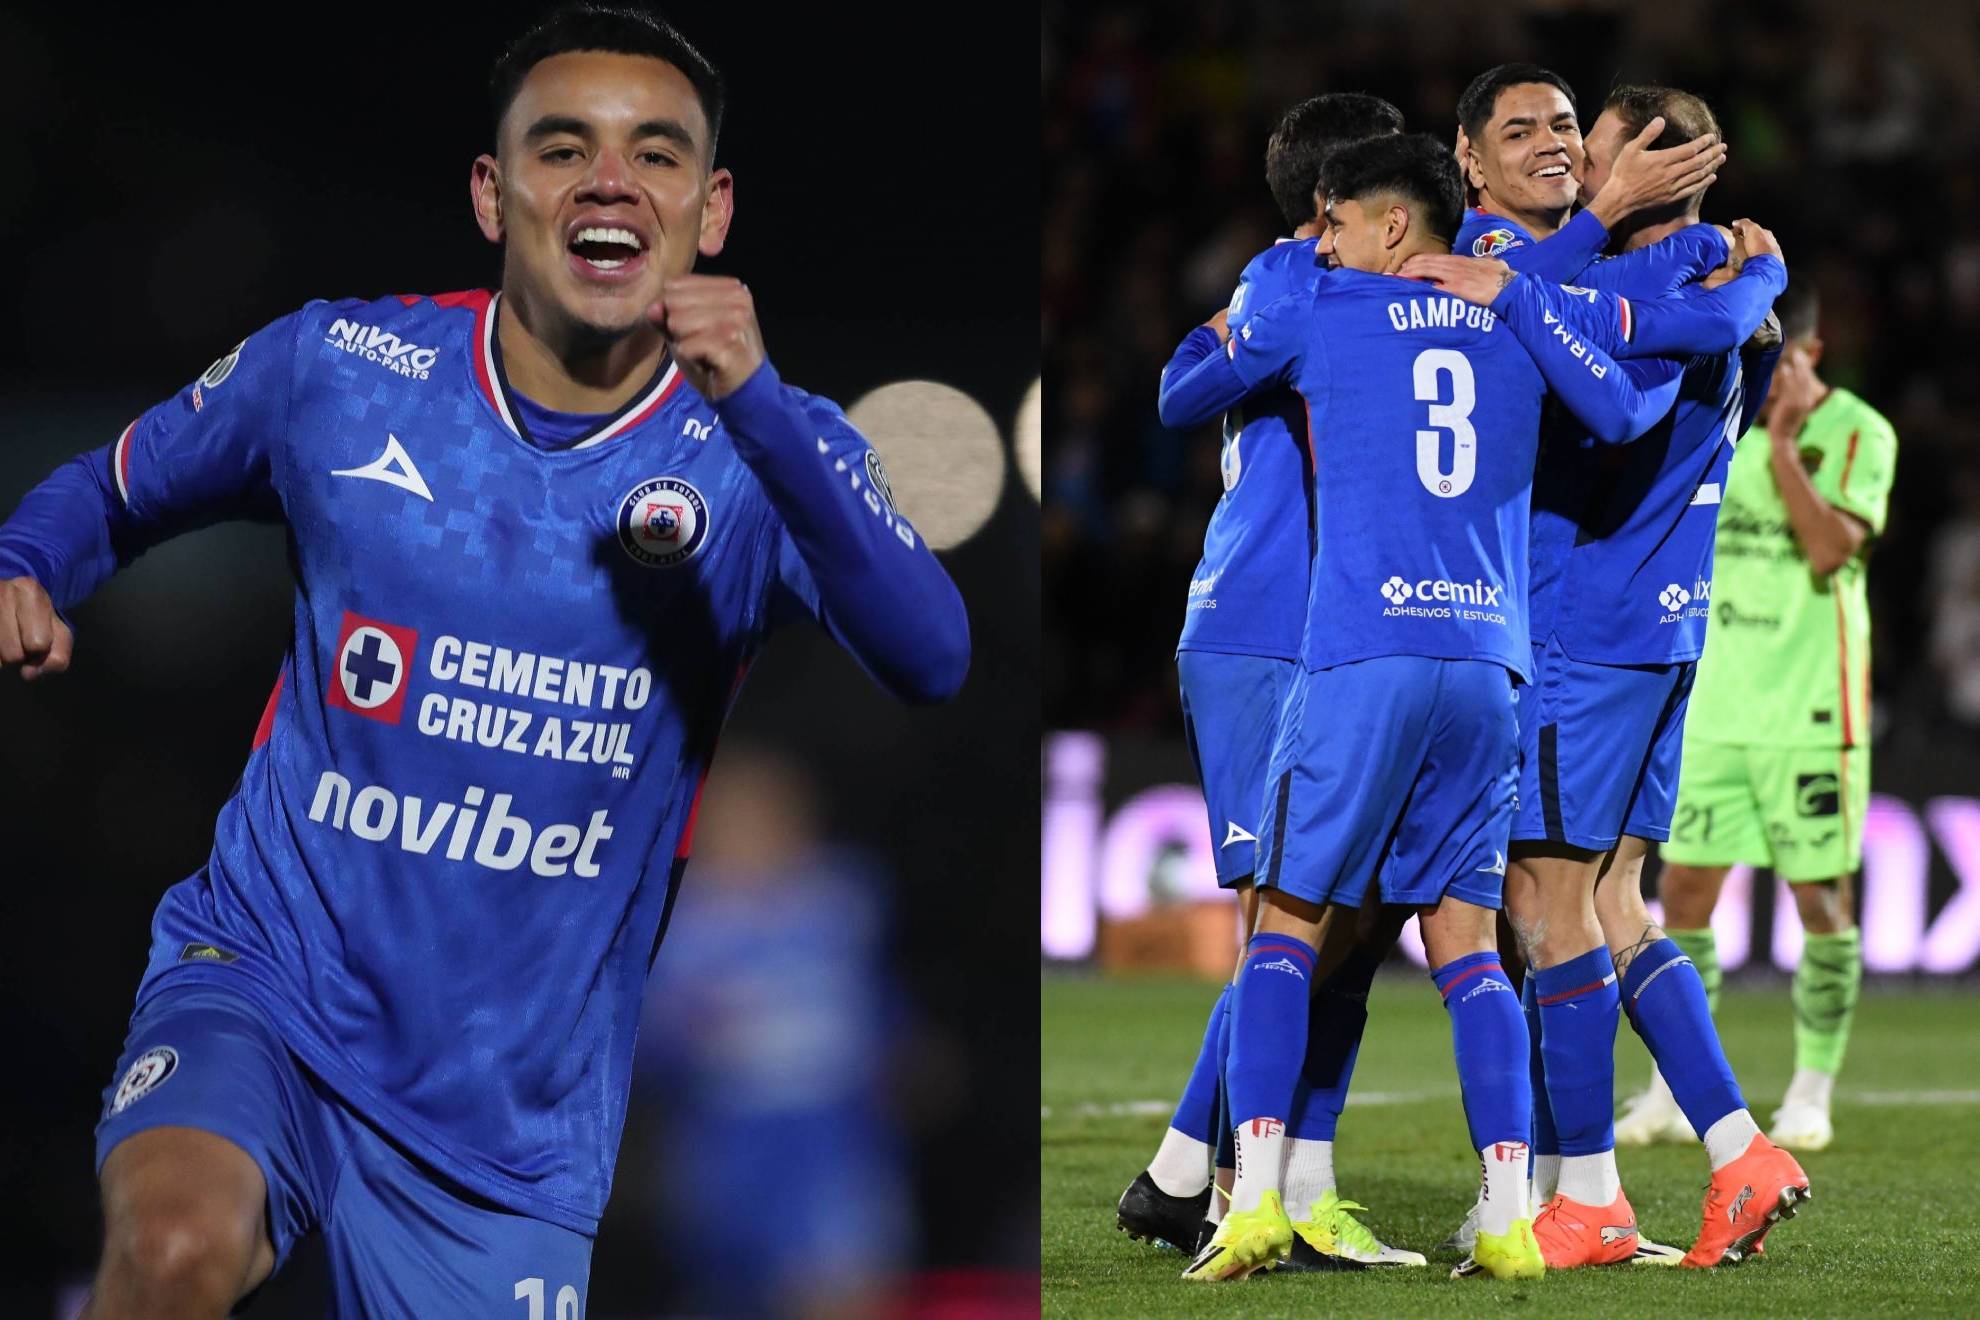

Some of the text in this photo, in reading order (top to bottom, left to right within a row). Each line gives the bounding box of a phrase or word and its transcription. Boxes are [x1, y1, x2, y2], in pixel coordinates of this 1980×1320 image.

[1544, 309, 1607, 379] PIRMA
[1412, 348, 1477, 498] 3
[1383, 606, 1507, 626] ADHESIVOS Y ESTUCOS
[1415, 578, 1499, 608] cemix
[429, 635, 652, 711] CEMENTO
[417, 693, 634, 764] CRUZ AZUL
[612, 765, 630, 780] MR
[308, 770, 614, 878] novibet
